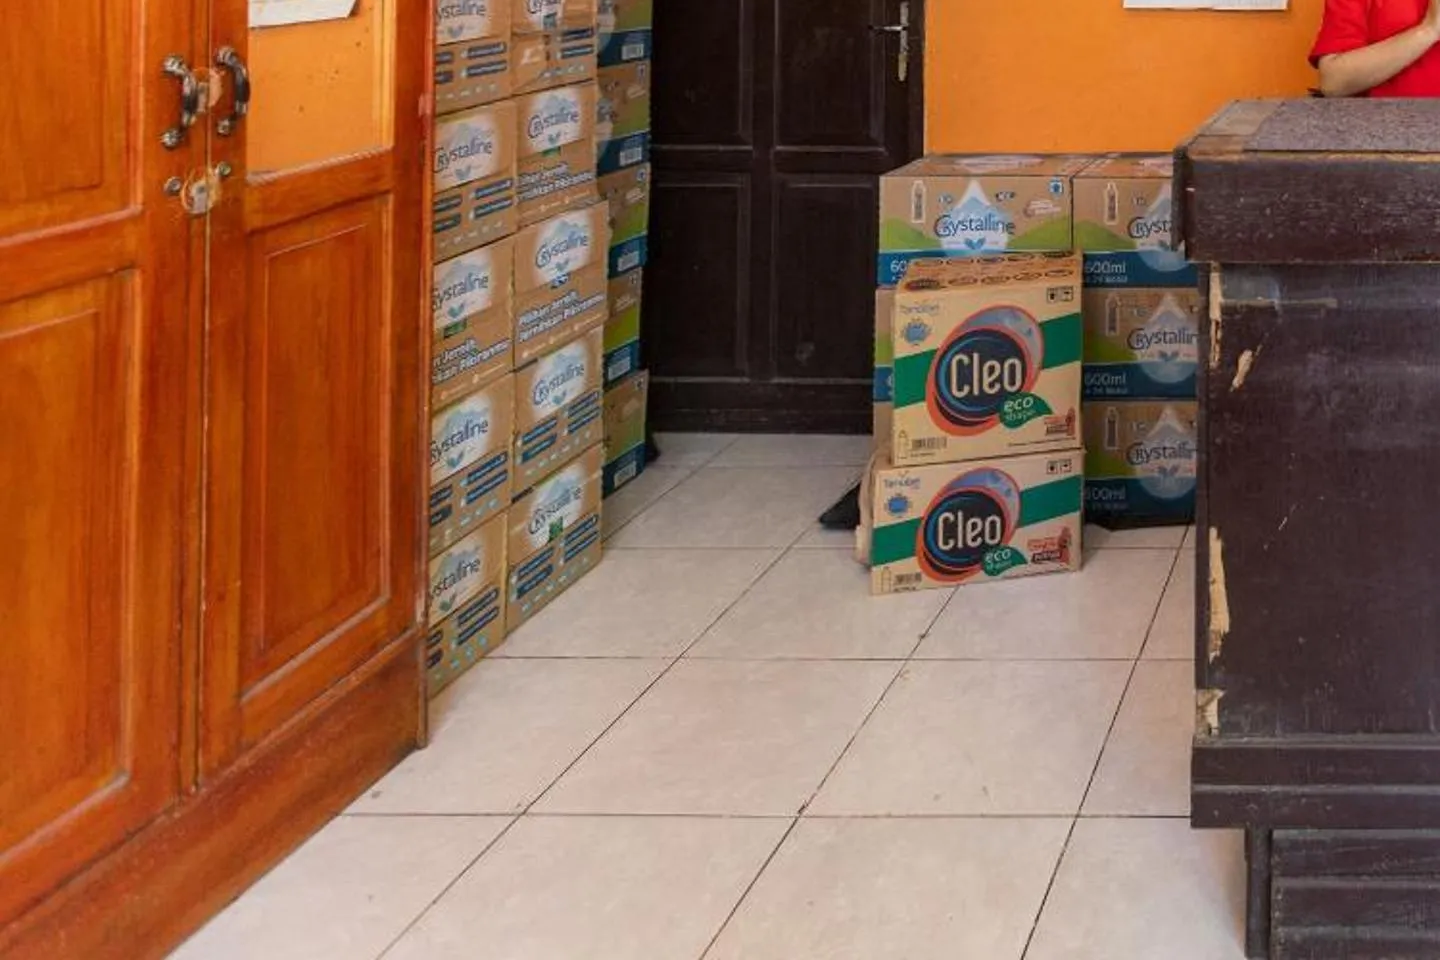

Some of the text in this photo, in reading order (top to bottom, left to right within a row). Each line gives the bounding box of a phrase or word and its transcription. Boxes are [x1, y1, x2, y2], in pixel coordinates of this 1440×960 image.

[934, 214, 1016, 238] Crystalline
[951, 352, 1023, 398] Cleo
[1003, 397, 1034, 413] eco
[937, 511, 1002, 551] Cleo
[984, 548, 1012, 563] eco
